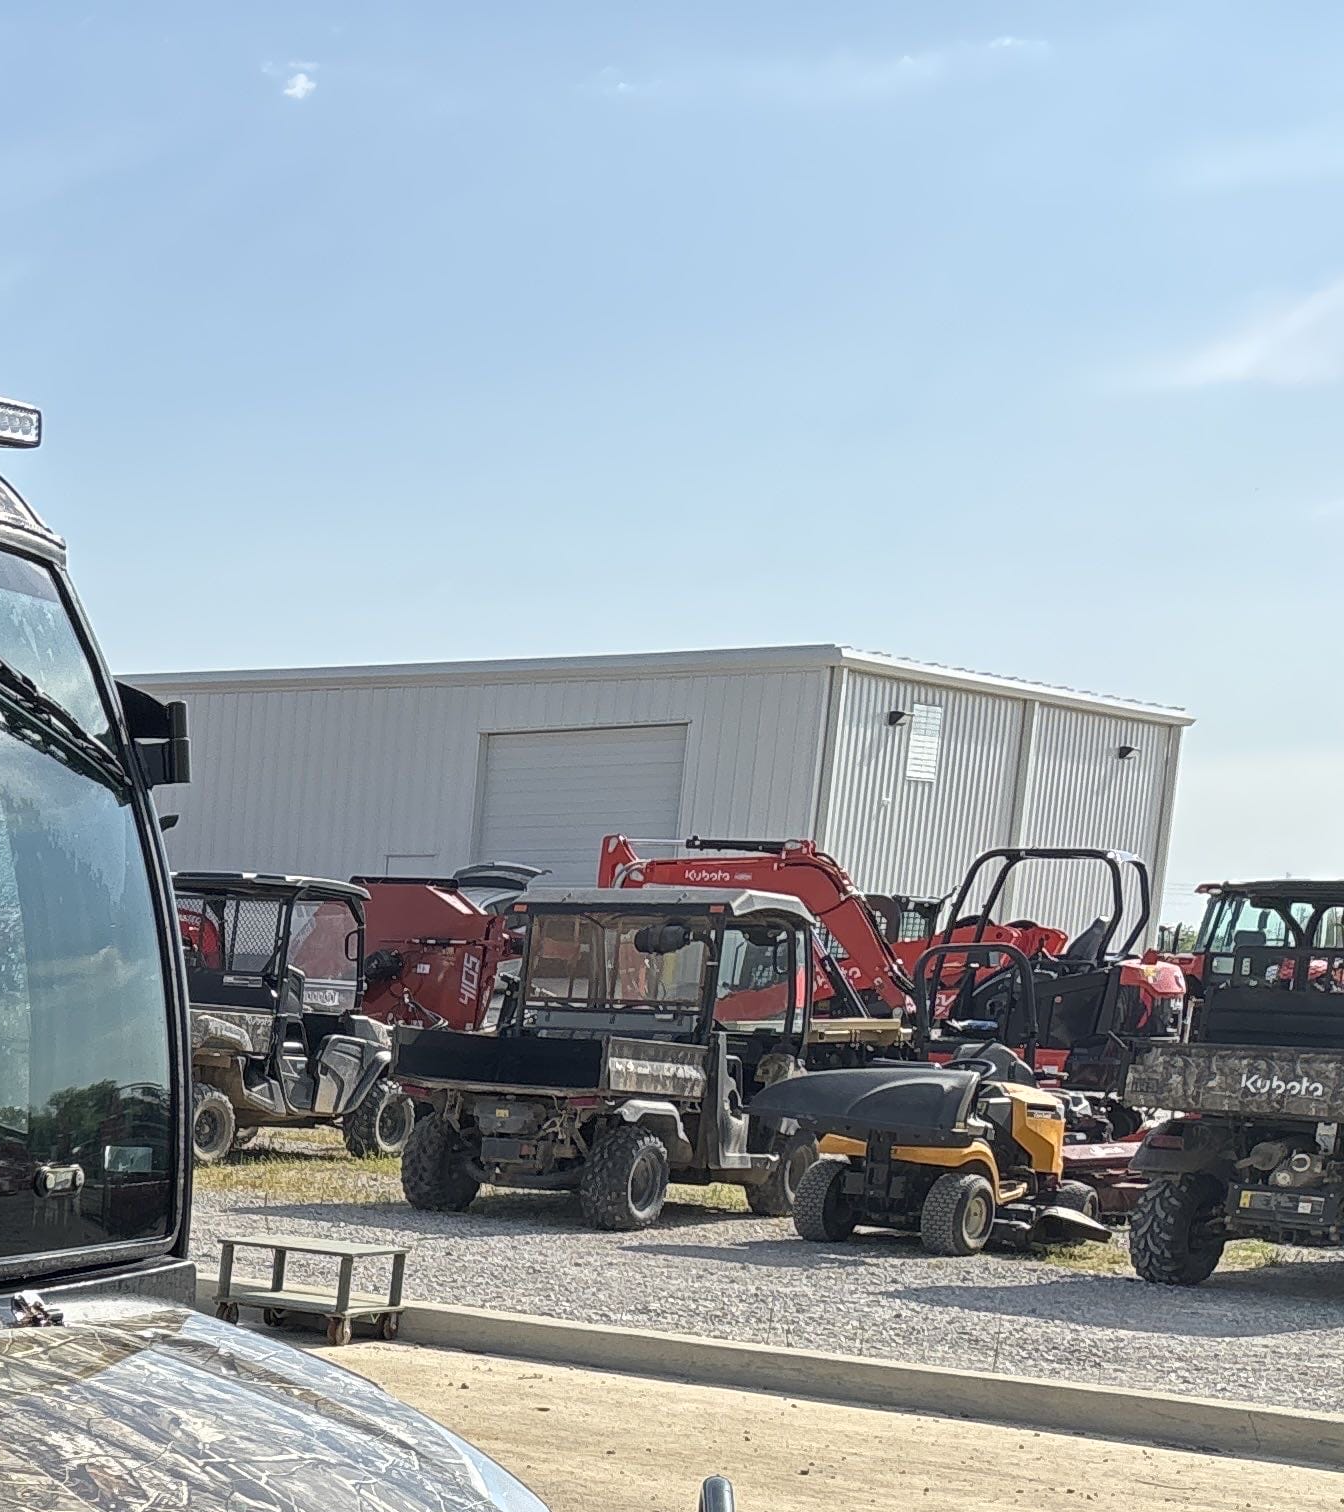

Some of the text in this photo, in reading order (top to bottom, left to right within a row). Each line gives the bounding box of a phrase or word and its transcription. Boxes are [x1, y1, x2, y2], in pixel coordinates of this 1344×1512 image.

[684, 869, 731, 883] Kubota
[459, 952, 481, 1005] 4105
[1240, 1073, 1324, 1098] Kubota
